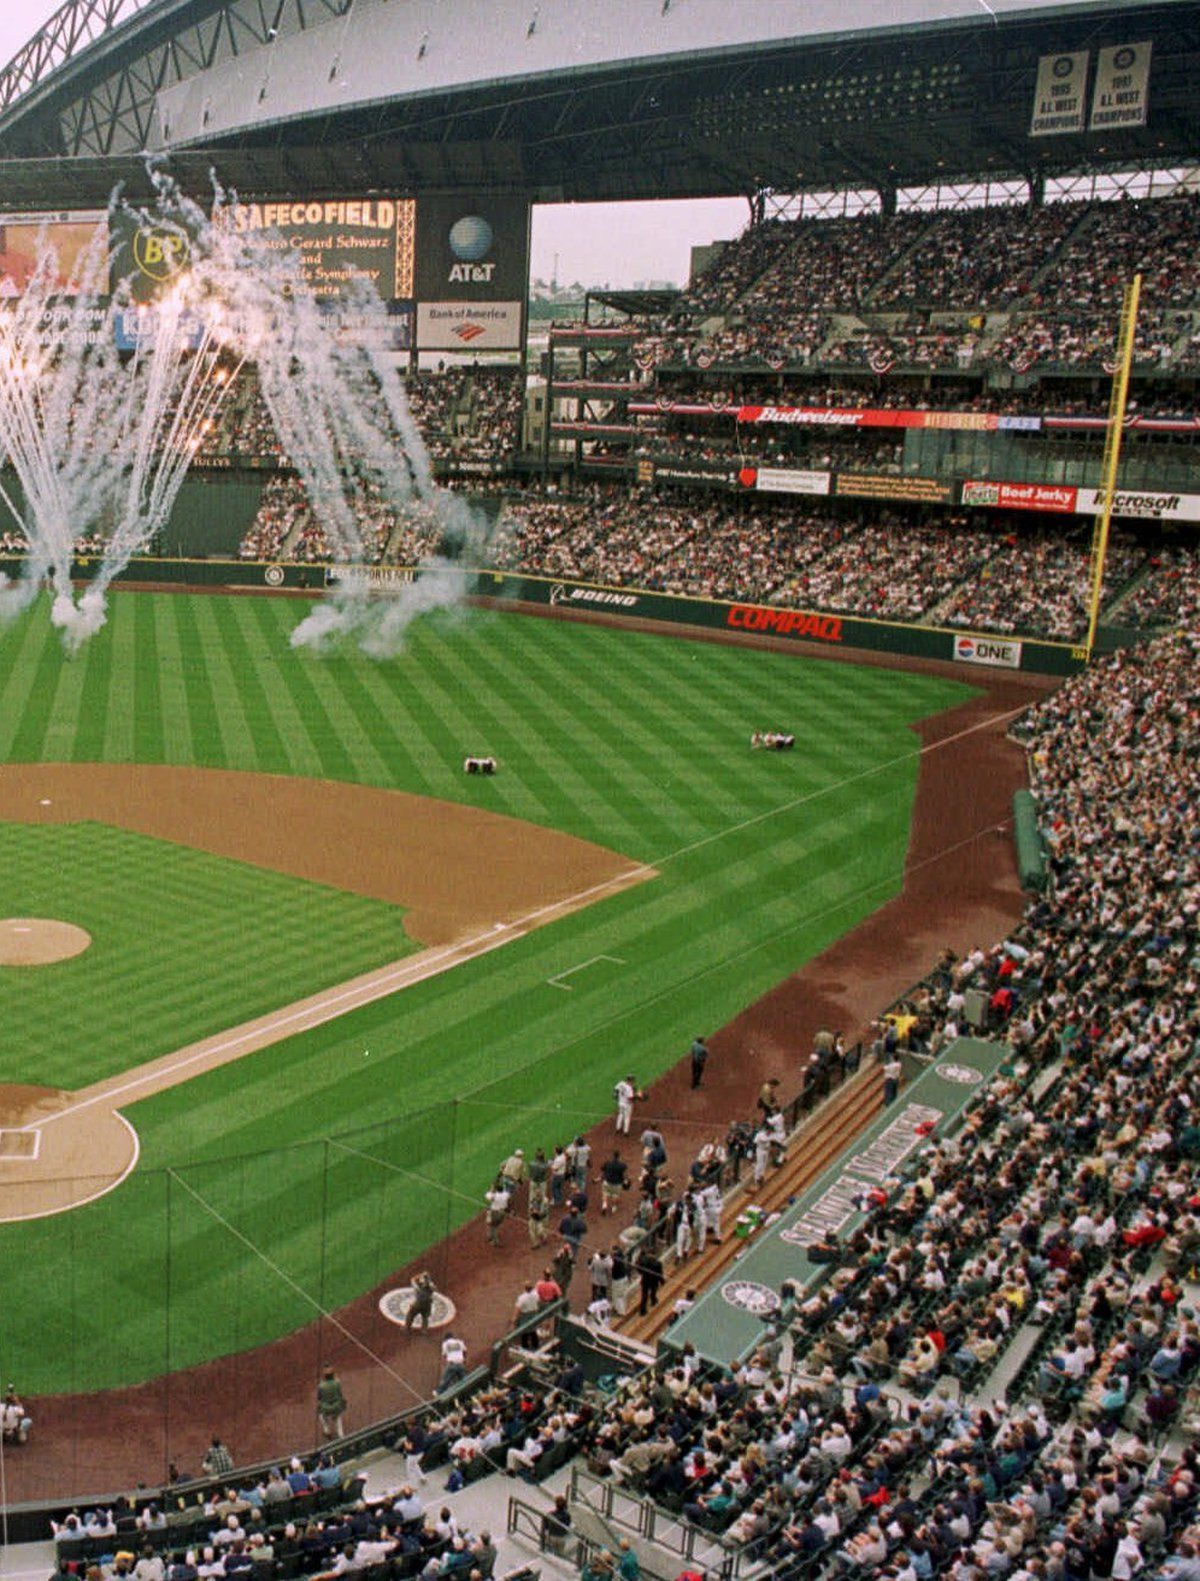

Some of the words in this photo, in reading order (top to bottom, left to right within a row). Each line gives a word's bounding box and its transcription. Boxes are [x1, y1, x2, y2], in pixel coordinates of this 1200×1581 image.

[1055, 98, 1077, 111] WEST
[1116, 91, 1139, 104] WEST
[1033, 115, 1079, 130] CHAMPIONS
[1093, 108, 1143, 124] CHAMPIONS
[234, 203, 323, 234] SAFECO
[325, 202, 395, 229] FIELD
[145, 236, 182, 263] BP
[290, 236, 333, 250] Gerard
[336, 234, 391, 249] Schwarz
[300, 253, 322, 265] and
[448, 264, 496, 282] AT&T
[429, 309, 454, 320] Bank
[455, 310, 466, 320] of
[467, 308, 508, 320] America
[758, 407, 864, 424] Budweiser
[1001, 487, 1033, 500] Beef
[1034, 488, 1073, 504] Jerky
[1093, 492, 1182, 512] Mcrosoft
[571, 588, 636, 607] BOEING
[727, 604, 841, 640] COMPAQ
[976, 643, 1013, 660] ONE
